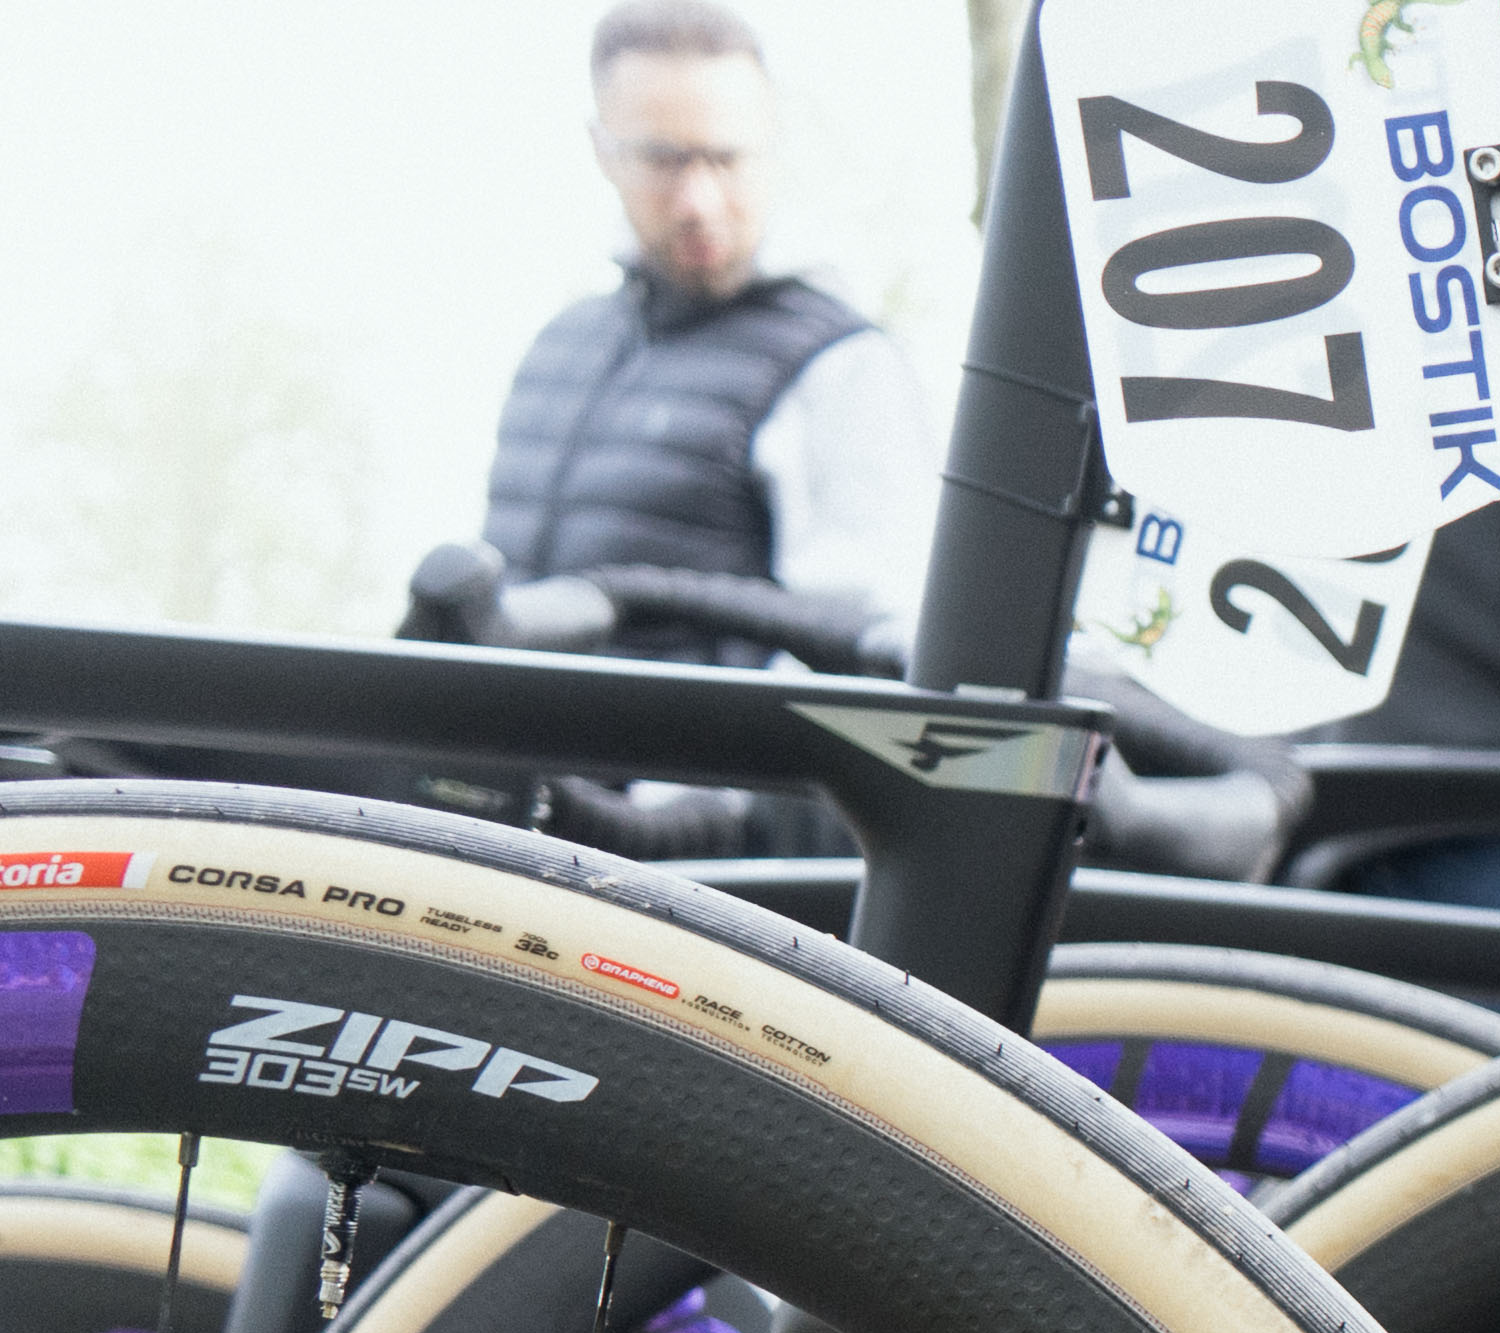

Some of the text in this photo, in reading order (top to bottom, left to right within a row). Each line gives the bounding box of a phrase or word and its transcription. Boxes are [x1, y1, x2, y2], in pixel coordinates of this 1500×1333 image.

[1078, 80, 1376, 432] 207
[167, 864, 406, 916] CORSA PRO
[418, 915, 471, 935] READY
[426, 906, 503, 934] TUBELESS
[514, 938, 560, 962] 32c
[599, 961, 678, 997] GRAPHENE
[694, 993, 743, 1021] RACE
[208, 994, 600, 1102] ZIPP
[761, 1023, 832, 1064] COTTON
